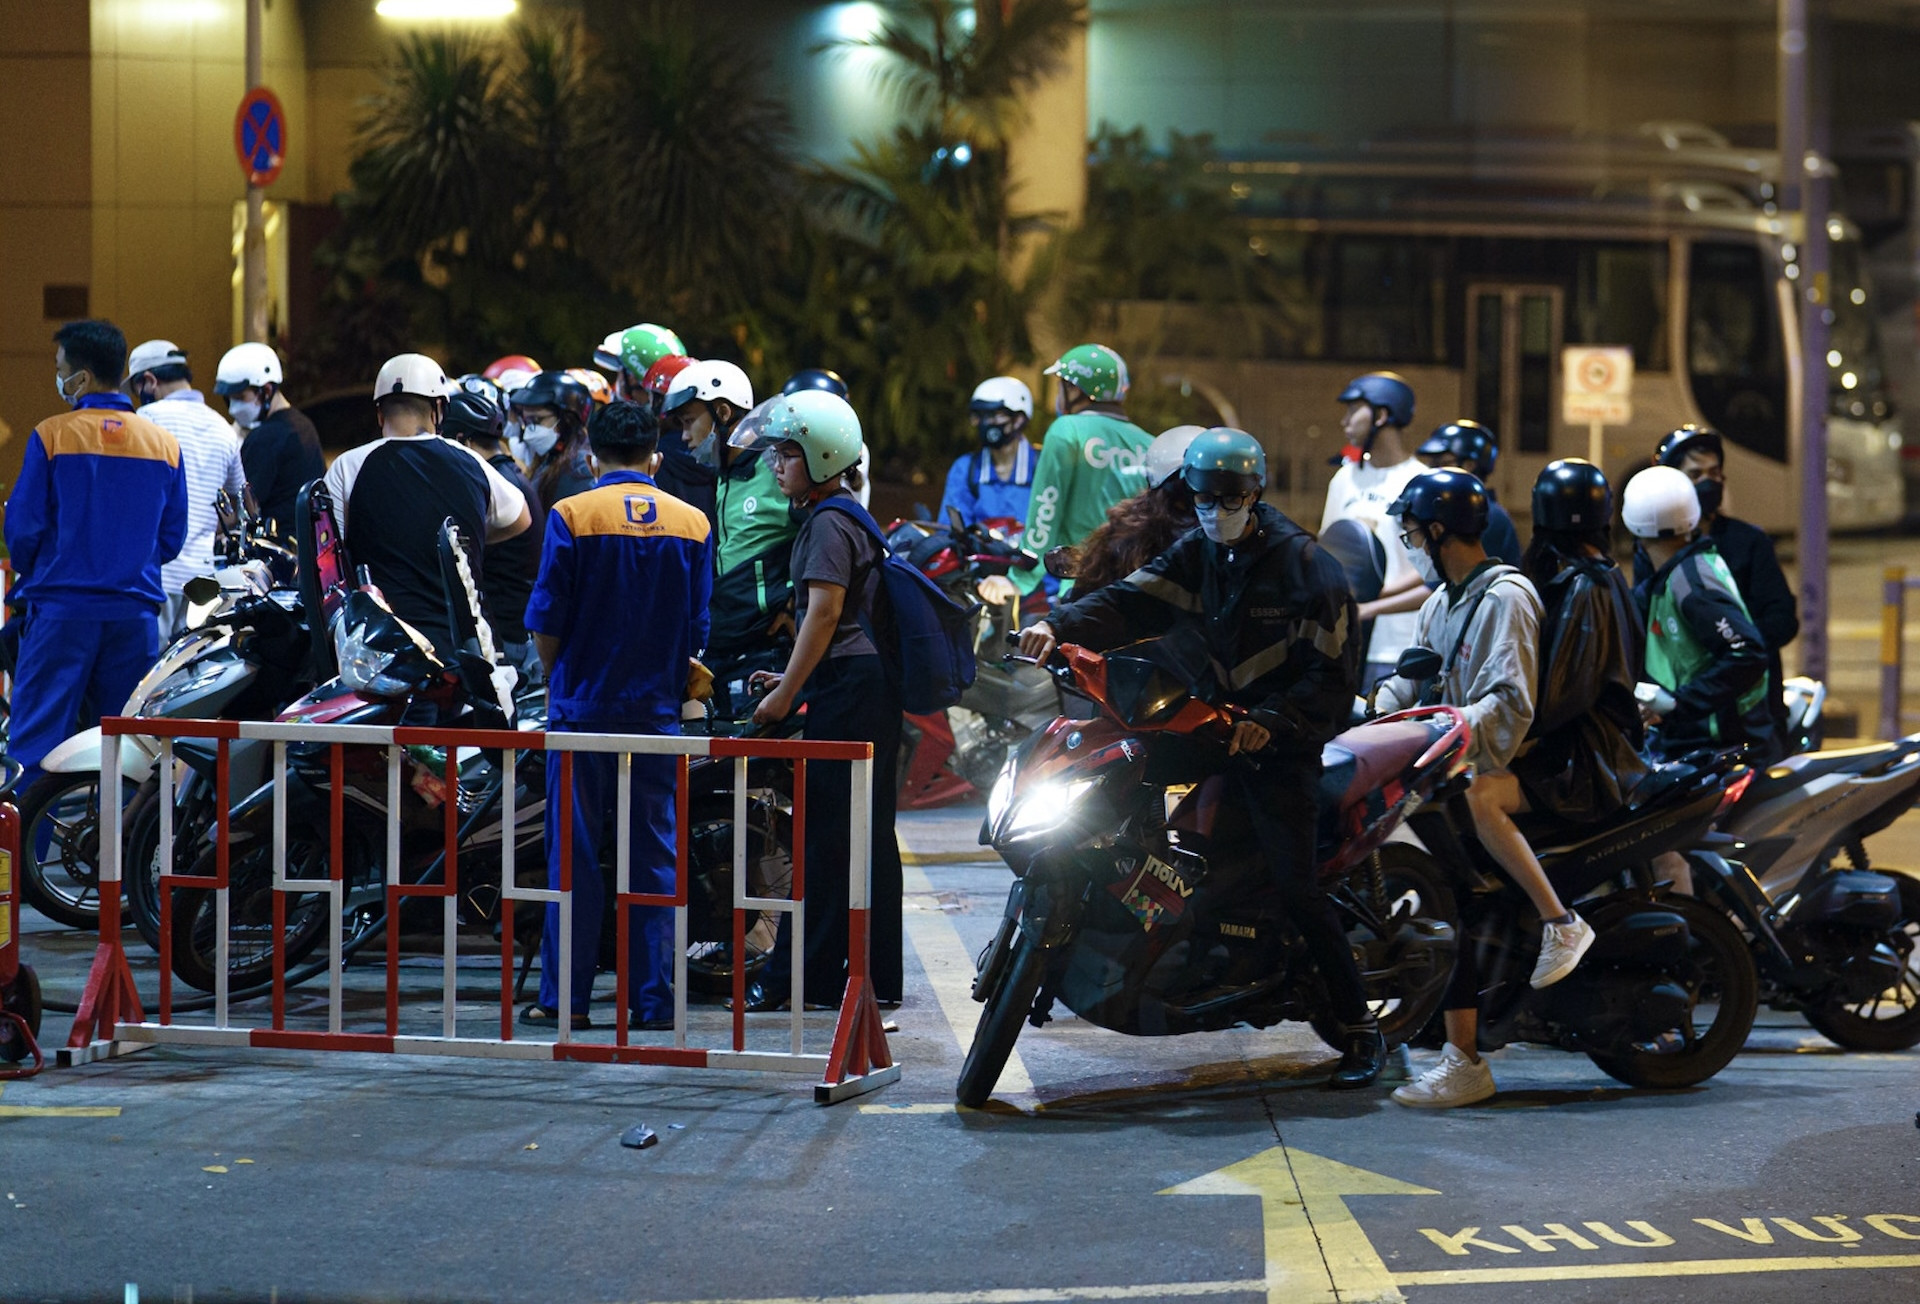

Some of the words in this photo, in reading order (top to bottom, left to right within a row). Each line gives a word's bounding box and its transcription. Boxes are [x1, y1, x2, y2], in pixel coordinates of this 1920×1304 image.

[1027, 486, 1059, 549] Grab
[1219, 922, 1256, 939] YAMAHA
[1417, 1220, 1676, 1255] KHU
